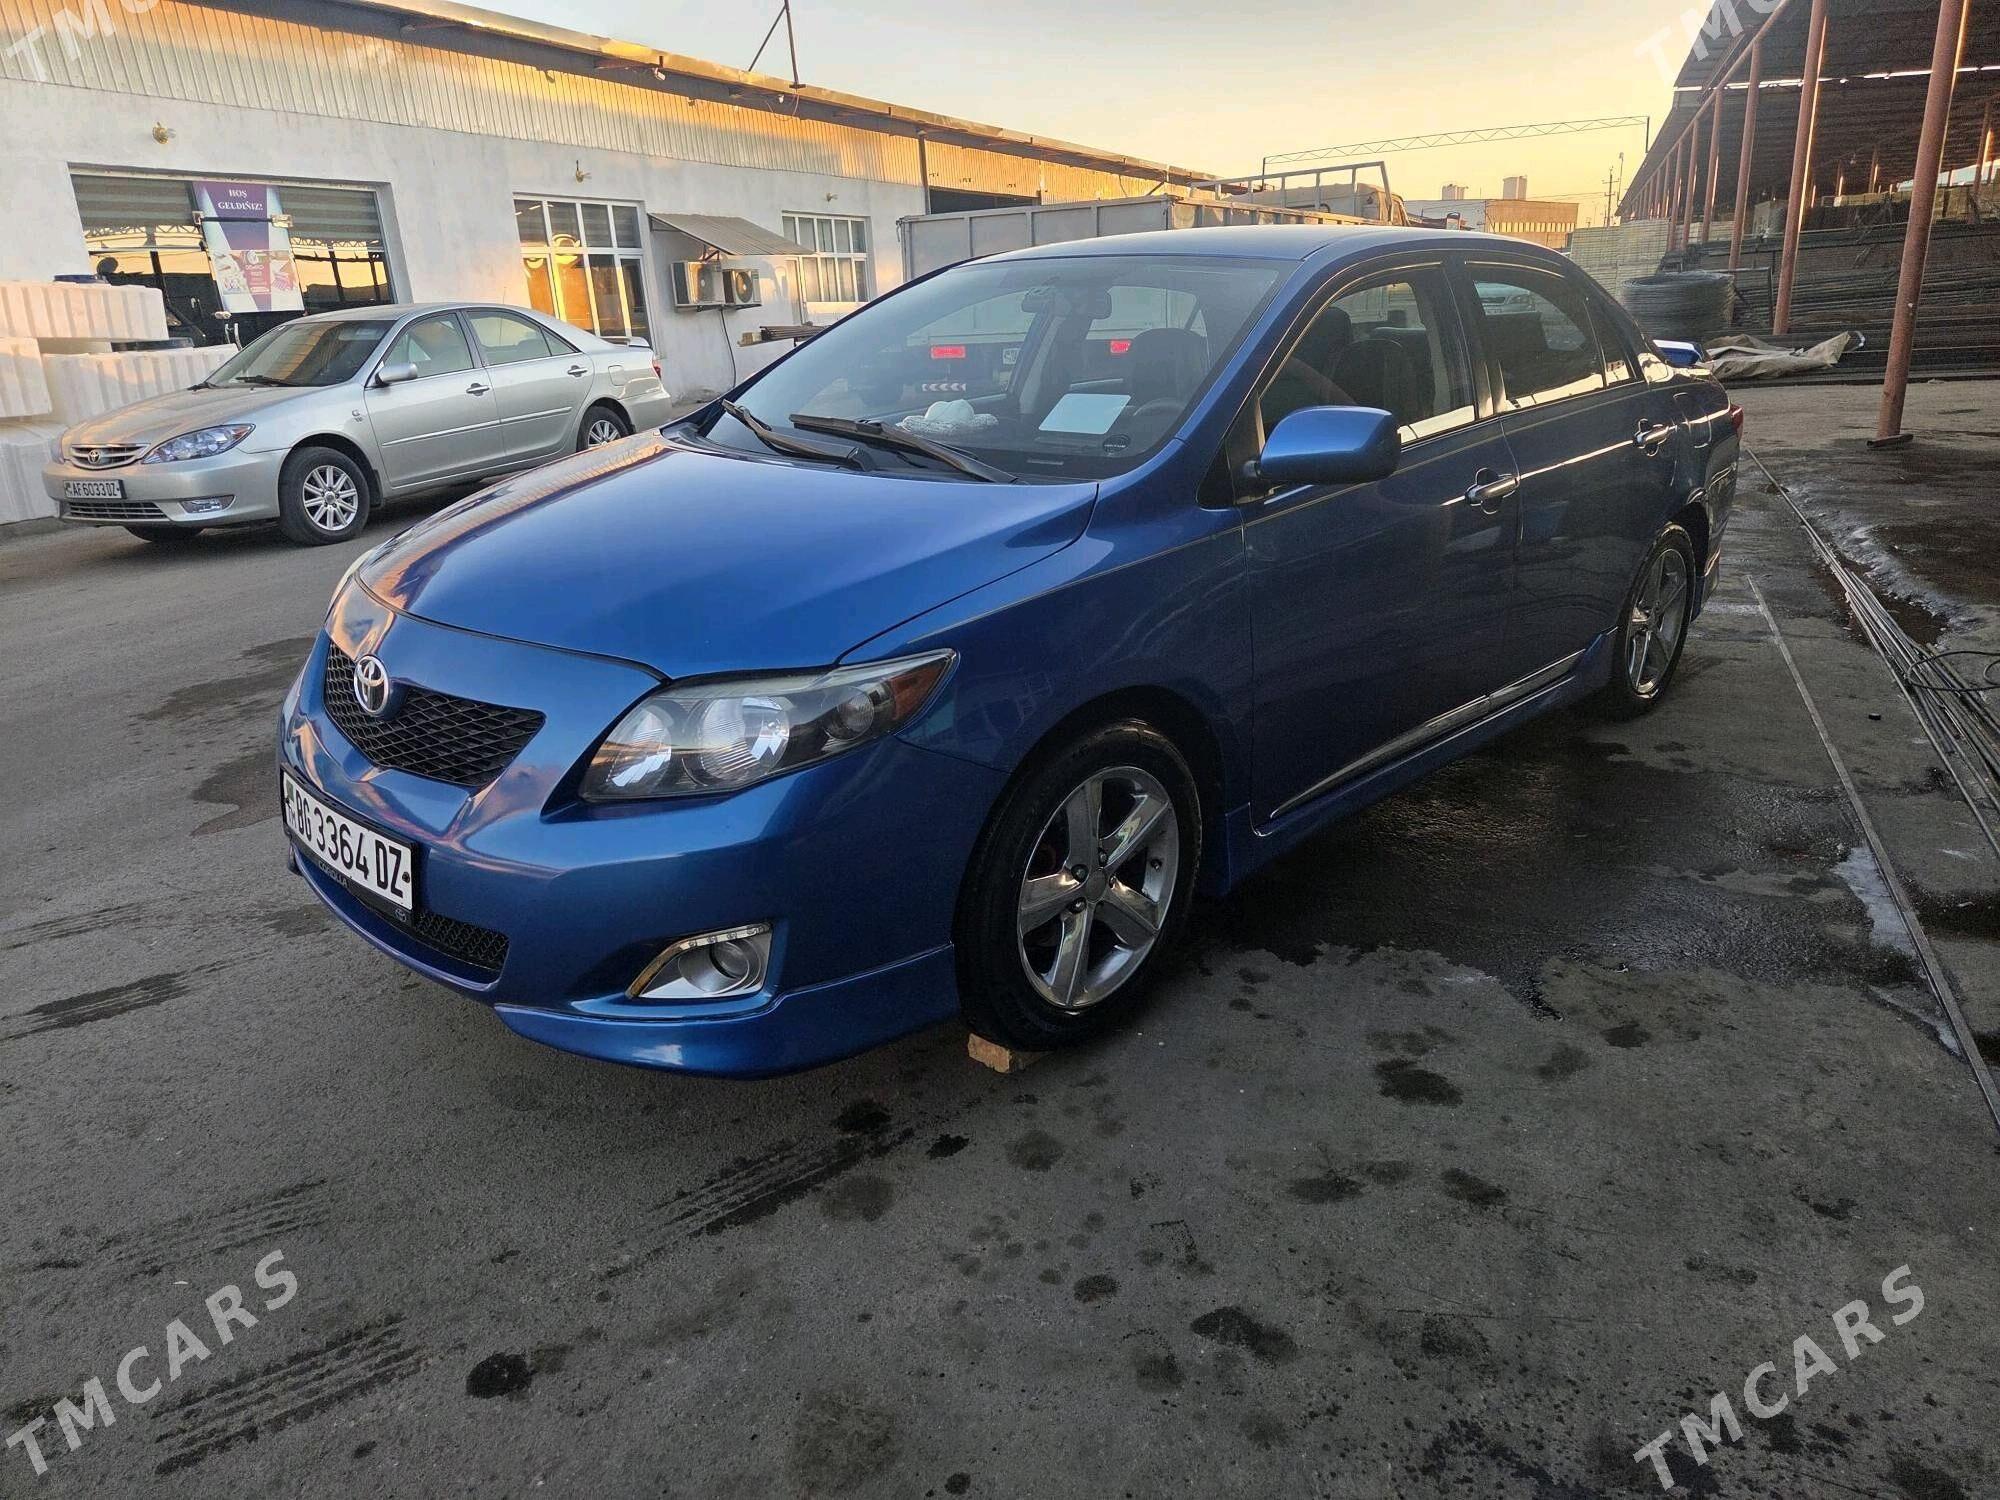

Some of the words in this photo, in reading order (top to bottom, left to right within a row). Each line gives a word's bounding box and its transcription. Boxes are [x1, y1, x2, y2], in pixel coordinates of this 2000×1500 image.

[295, 789, 312, 842] BG
[314, 807, 370, 880] 3364
[375, 839, 404, 899] DZ
